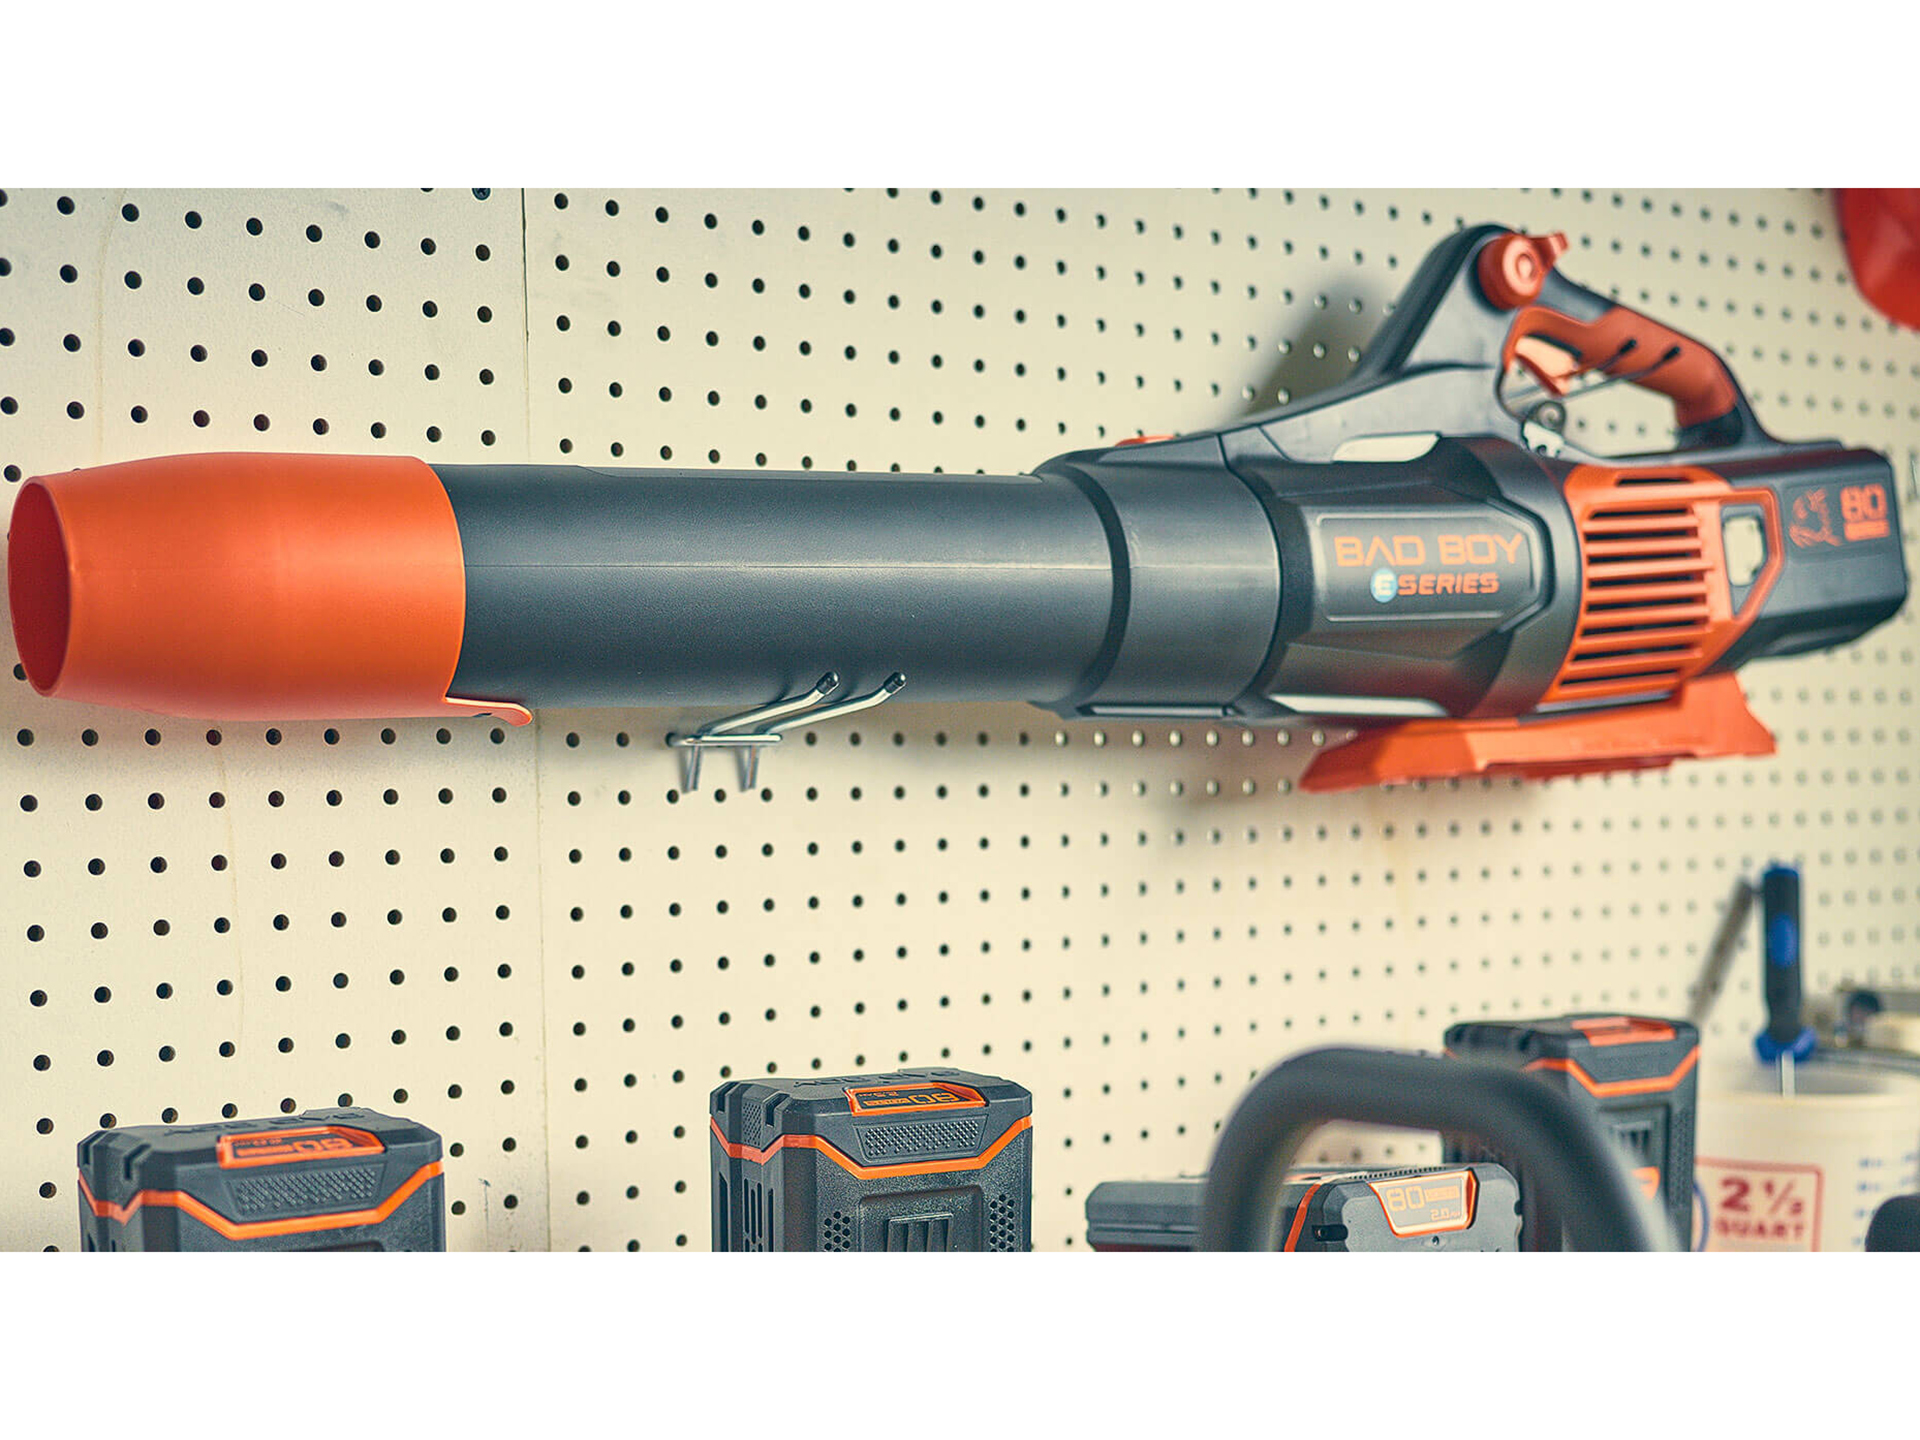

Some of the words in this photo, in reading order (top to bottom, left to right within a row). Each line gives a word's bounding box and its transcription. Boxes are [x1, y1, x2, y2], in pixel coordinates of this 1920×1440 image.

[1840, 483, 1887, 520] 80
[1334, 535, 1426, 567] BAD
[1437, 533, 1523, 565] BOY
[1397, 572, 1500, 596] SERIES
[909, 1092, 960, 1104] 80
[1385, 1185, 1425, 1212] 80
